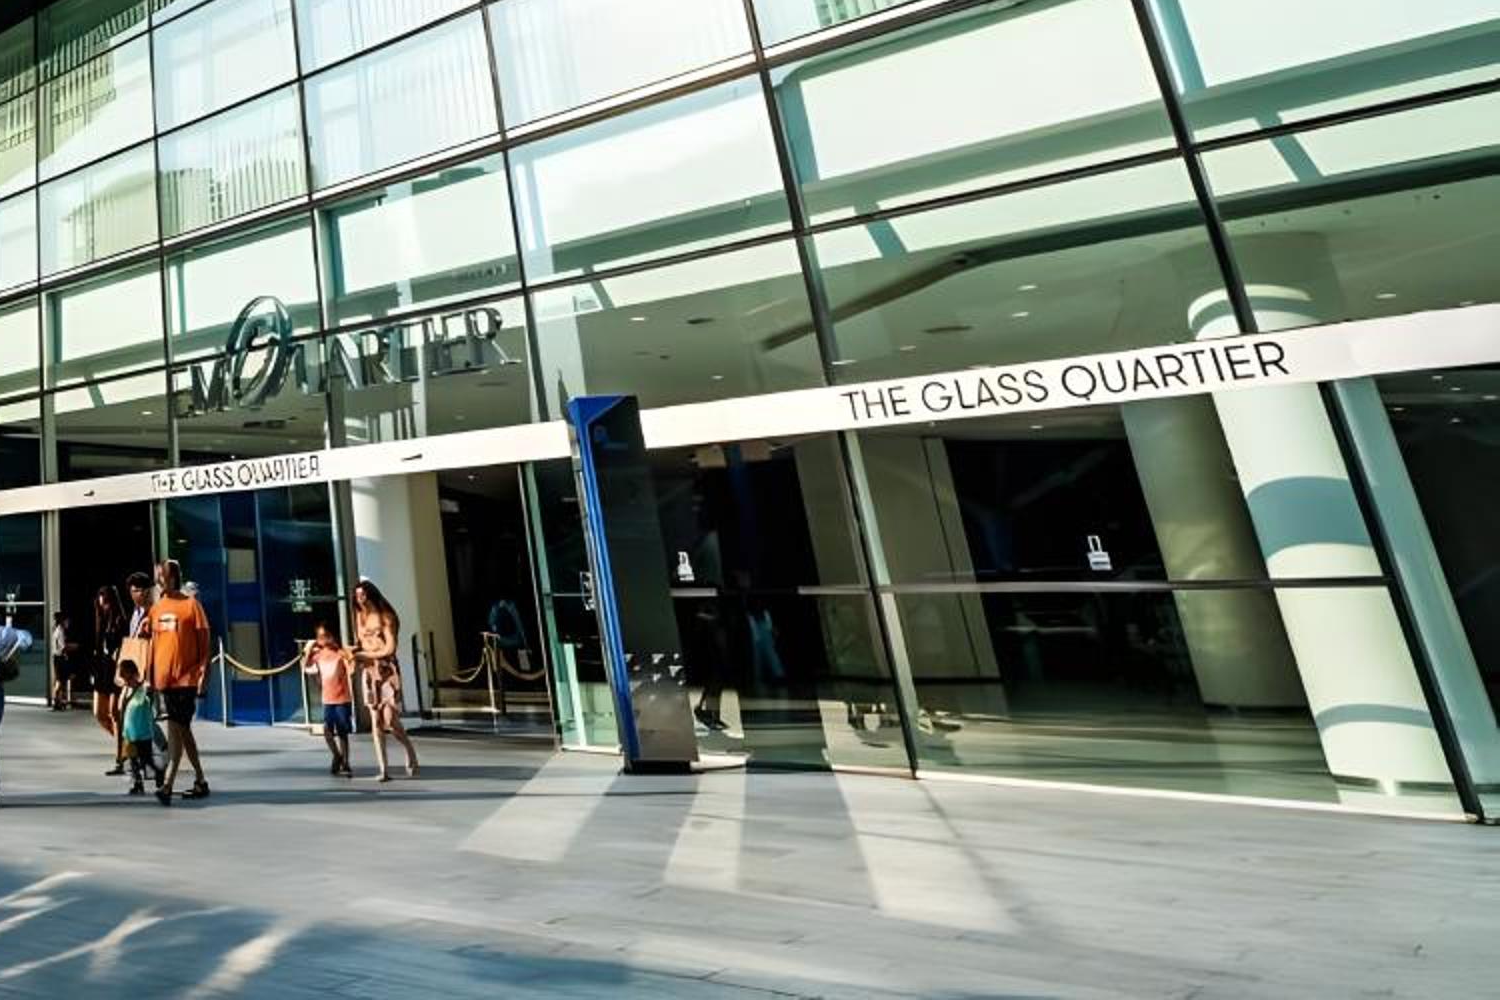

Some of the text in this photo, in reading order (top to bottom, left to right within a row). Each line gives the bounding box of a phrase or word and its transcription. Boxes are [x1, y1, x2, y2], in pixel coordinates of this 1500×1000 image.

[841, 340, 1291, 422] THE GLASS QUARTIER
